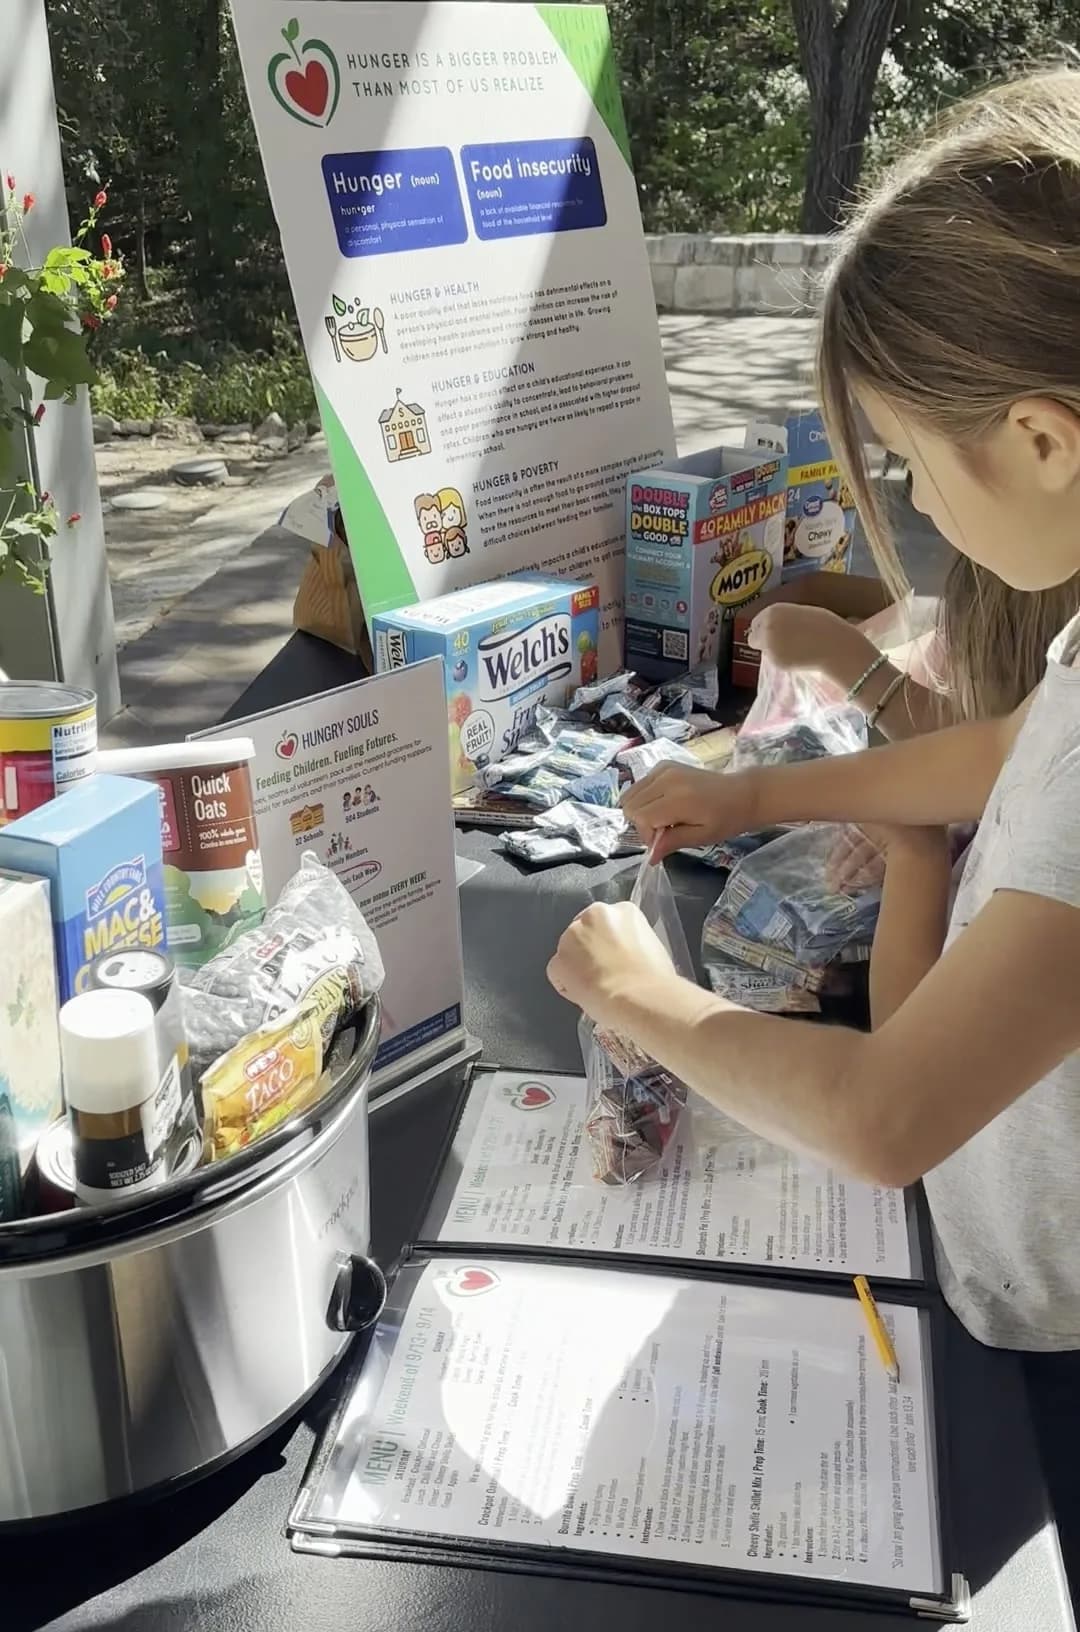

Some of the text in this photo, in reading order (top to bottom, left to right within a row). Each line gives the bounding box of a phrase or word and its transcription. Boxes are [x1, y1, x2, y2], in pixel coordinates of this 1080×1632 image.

[347, 50, 559, 69] HUNGER IS A BIGGER PROBLEM
[352, 76, 544, 97] THAN MOST OF US REALIZE
[470, 153, 591, 182] Food insecurity
[332, 172, 440, 196] Hunger (noun)
[477, 187, 502, 200] (noun)
[390, 282, 480, 304] HUNGER HEALTH
[432, 362, 535, 392] HUNGER EDUCATION
[472, 474, 510, 493] HUNGER
[521, 461, 558, 479] POVERTY
[800, 467, 826, 480] FAMILY
[476, 496, 492, 508] Food
[492, 490, 522, 503] insecurity
[530, 483, 544, 492] often
[546, 479, 555, 488] the
[586, 468, 598, 476] more
[478, 475, 614, 521] When there not enough food around and
[632, 486, 688, 508] DOUBLE
[788, 488, 800, 502] 24
[480, 525, 495, 534] have
[497, 520, 506, 528] the
[508, 512, 537, 526] resources
[546, 504, 560, 514] meet
[644, 504, 686, 519] BOX TOPS
[700, 492, 786, 535] 40 FAMILY PACK
[484, 508, 591, 548] difficult choices between feeding their
[632, 512, 687, 535] DOUBLE
[644, 532, 668, 542] GOOD
[808, 529, 832, 541] Chewy
[542, 546, 590, 567] impacts child's
[568, 558, 592, 572] children
[574, 590, 596, 603] FAMILY
[454, 631, 470, 648] 40
[482, 623, 569, 689] Welch's
[302, 709, 380, 750] HUNGRY SOULS
[466, 720, 487, 740] REAL
[256, 732, 399, 790] Feeding Children. Fueling Futures.
[330, 752, 386, 778] pack needed
[384, 754, 406, 768] funding
[56, 768, 85, 780] Calories
[192, 772, 232, 797] Quick
[194, 799, 227, 820] Oats
[356, 805, 380, 820] Students
[199, 829, 219, 840] 100%
[303, 829, 324, 844] Schools
[390, 880, 408, 894] EVERY
[84, 888, 156, 961] MAC &
[245, 1058, 294, 1114] TACO
[452, 1198, 480, 1223] MENU
[360, 1306, 436, 1486] MENU Weekend of 9/14
[758, 1380, 768, 1398] Time:
[756, 1398, 767, 1415] Cook
[394, 1449, 412, 1481] SATURDAY
[754, 1455, 768, 1472] Prep
[752, 1477, 763, 1488] Mix
[478, 1494, 496, 1526] Crockpot
[751, 1489, 762, 1511] Skillet
[558, 1509, 574, 1535] Burrito
[749, 1512, 761, 1532] Shells
[746, 1533, 760, 1557] Cheesy
